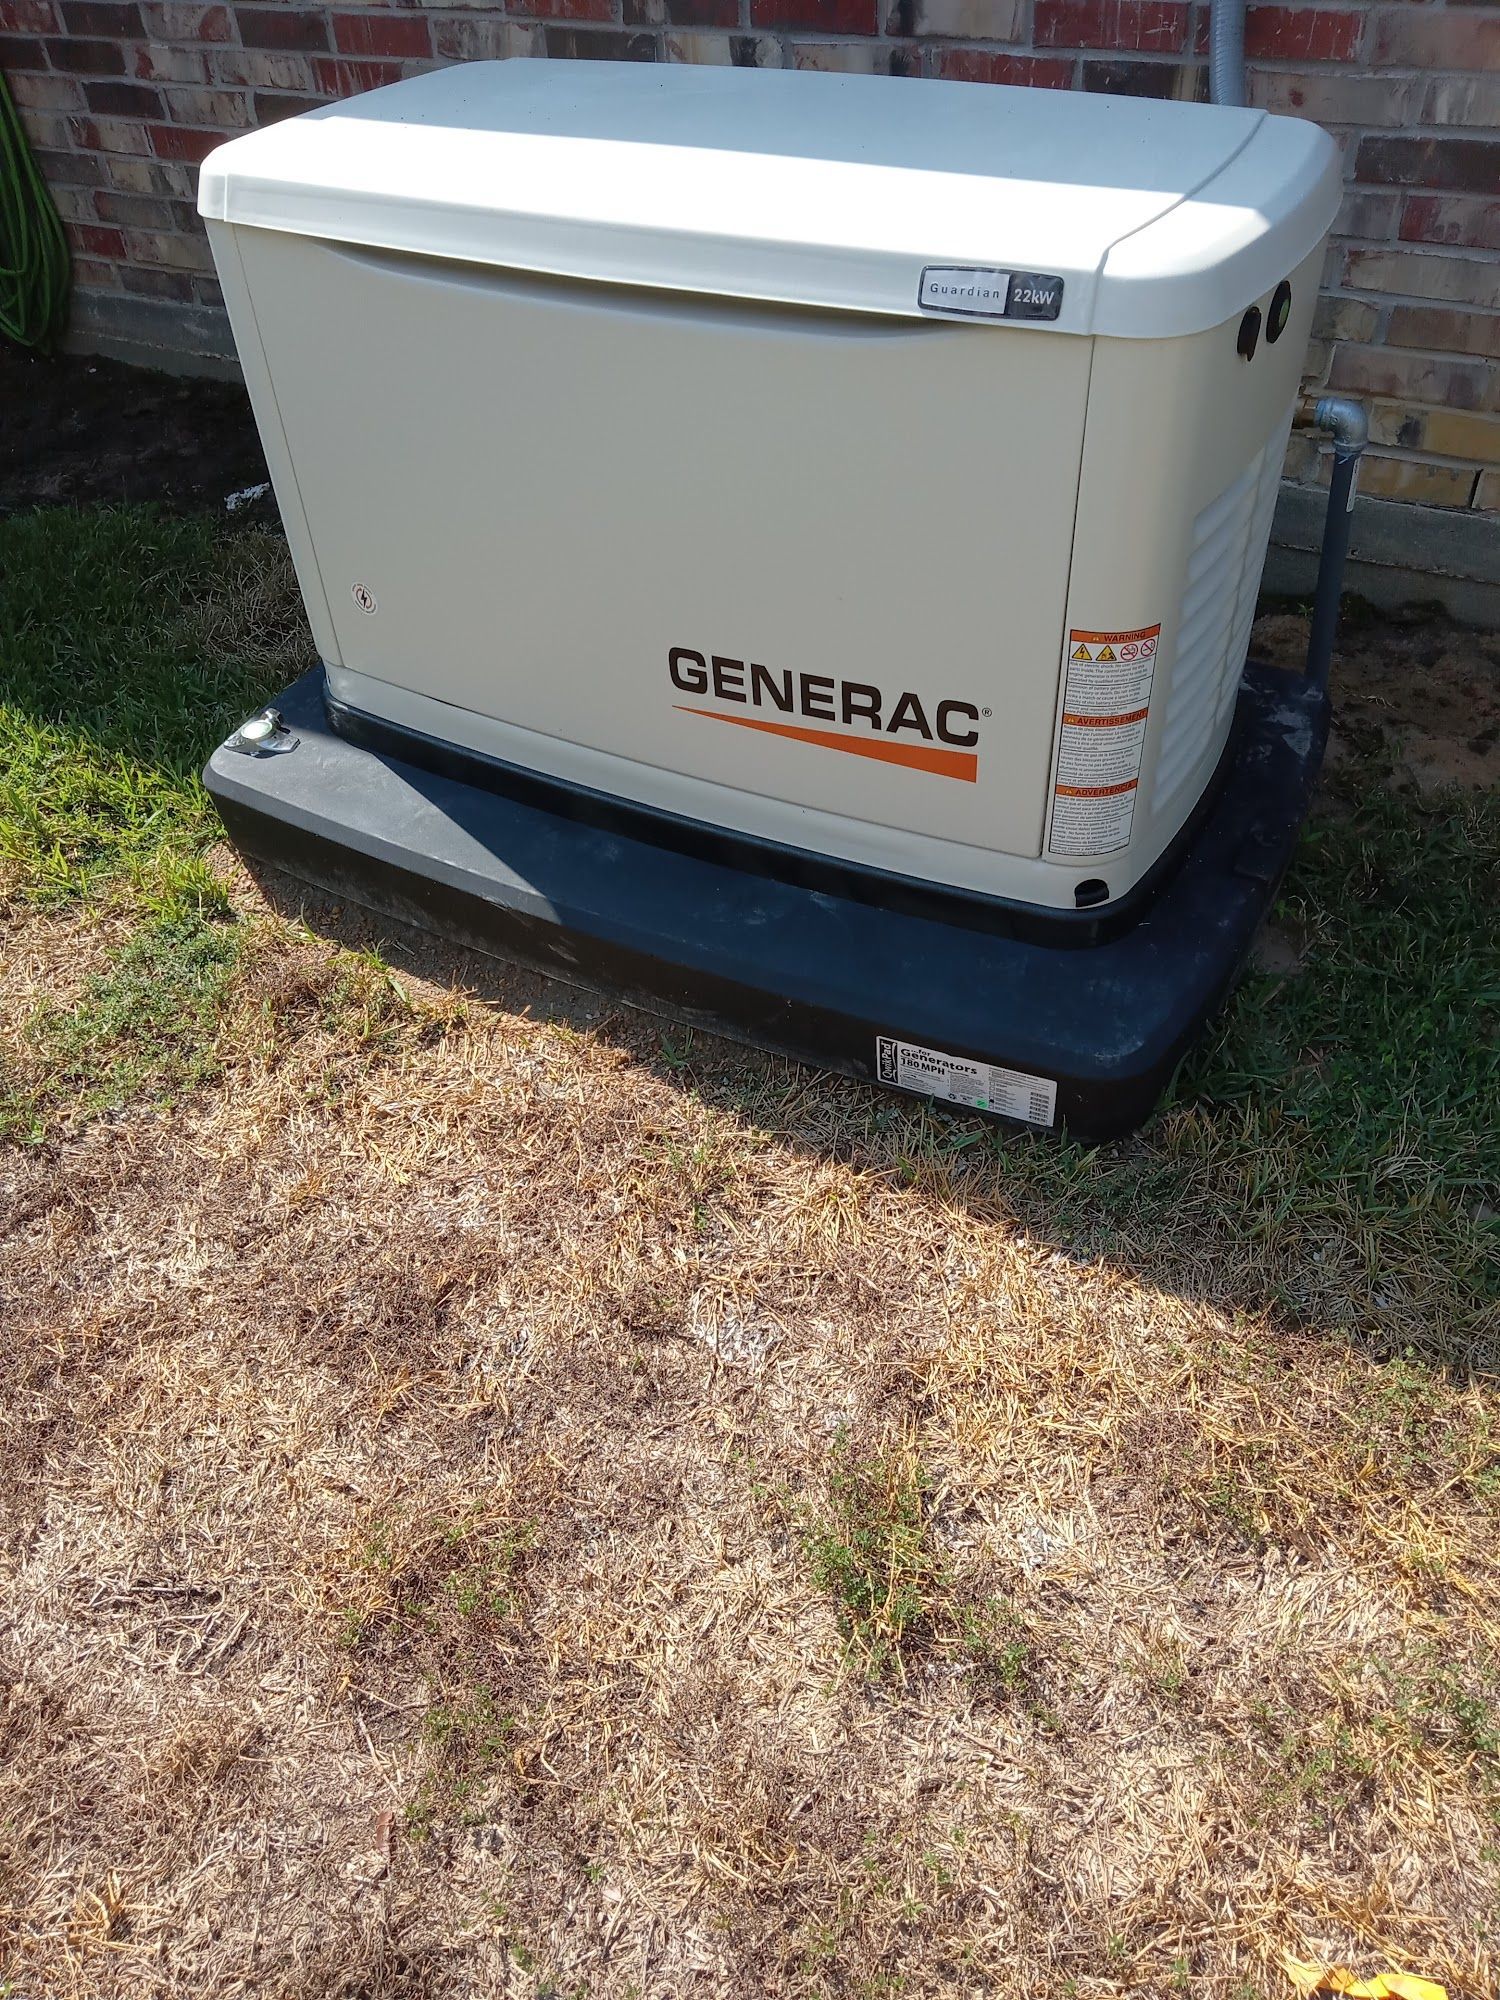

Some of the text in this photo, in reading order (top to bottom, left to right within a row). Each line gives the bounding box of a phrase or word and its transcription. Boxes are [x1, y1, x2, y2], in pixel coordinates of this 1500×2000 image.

[930, 283, 1055, 305] Guardian 22kW
[1103, 631, 1146, 642] WARNING
[1076, 711, 1147, 726] AVERTISSEMENT
[1075, 782, 1132, 796] ADVERTENCIA
[900, 1048, 978, 1075] Generators
[900, 1058, 945, 1075] 180 MPH
